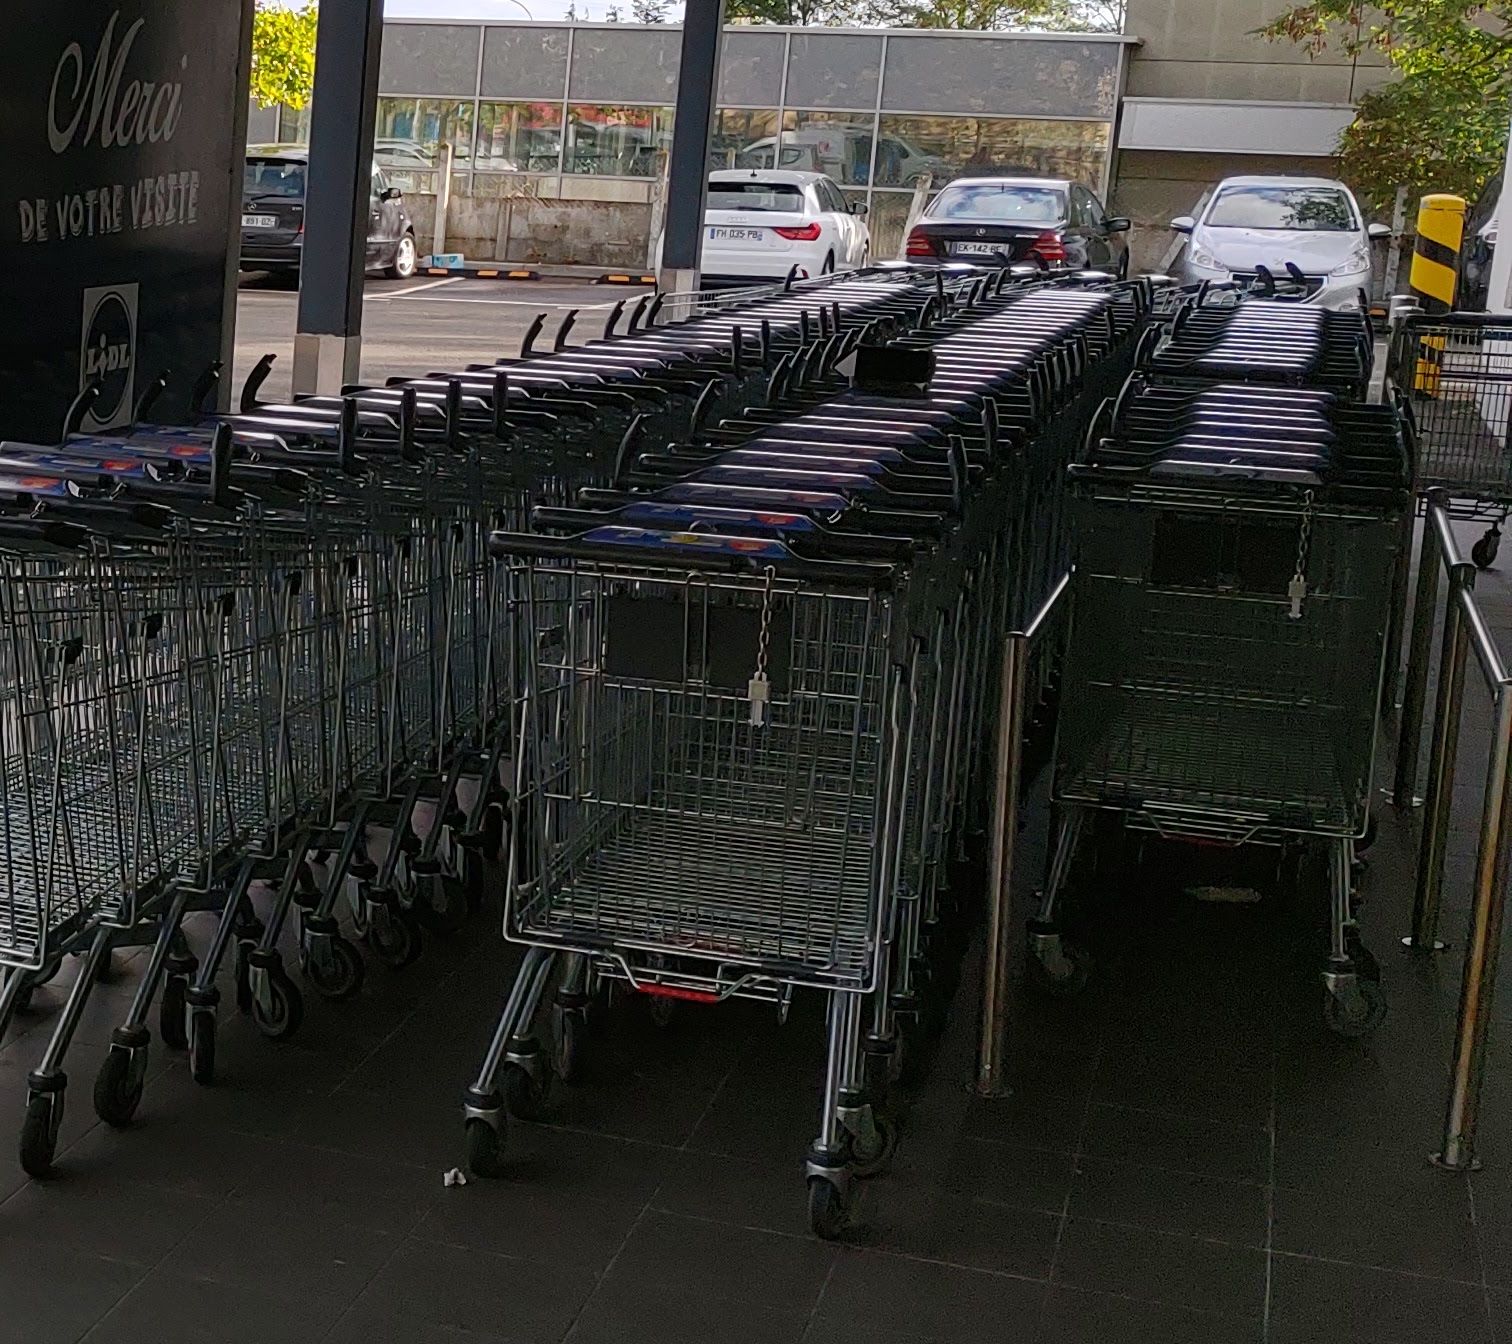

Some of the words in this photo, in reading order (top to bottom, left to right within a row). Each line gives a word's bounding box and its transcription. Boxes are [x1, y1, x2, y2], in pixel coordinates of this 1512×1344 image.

[47, 9, 188, 155] Merci
[19, 199, 49, 243] DE
[55, 184, 125, 240] VOTRE
[130, 170, 200, 230] VISITE
